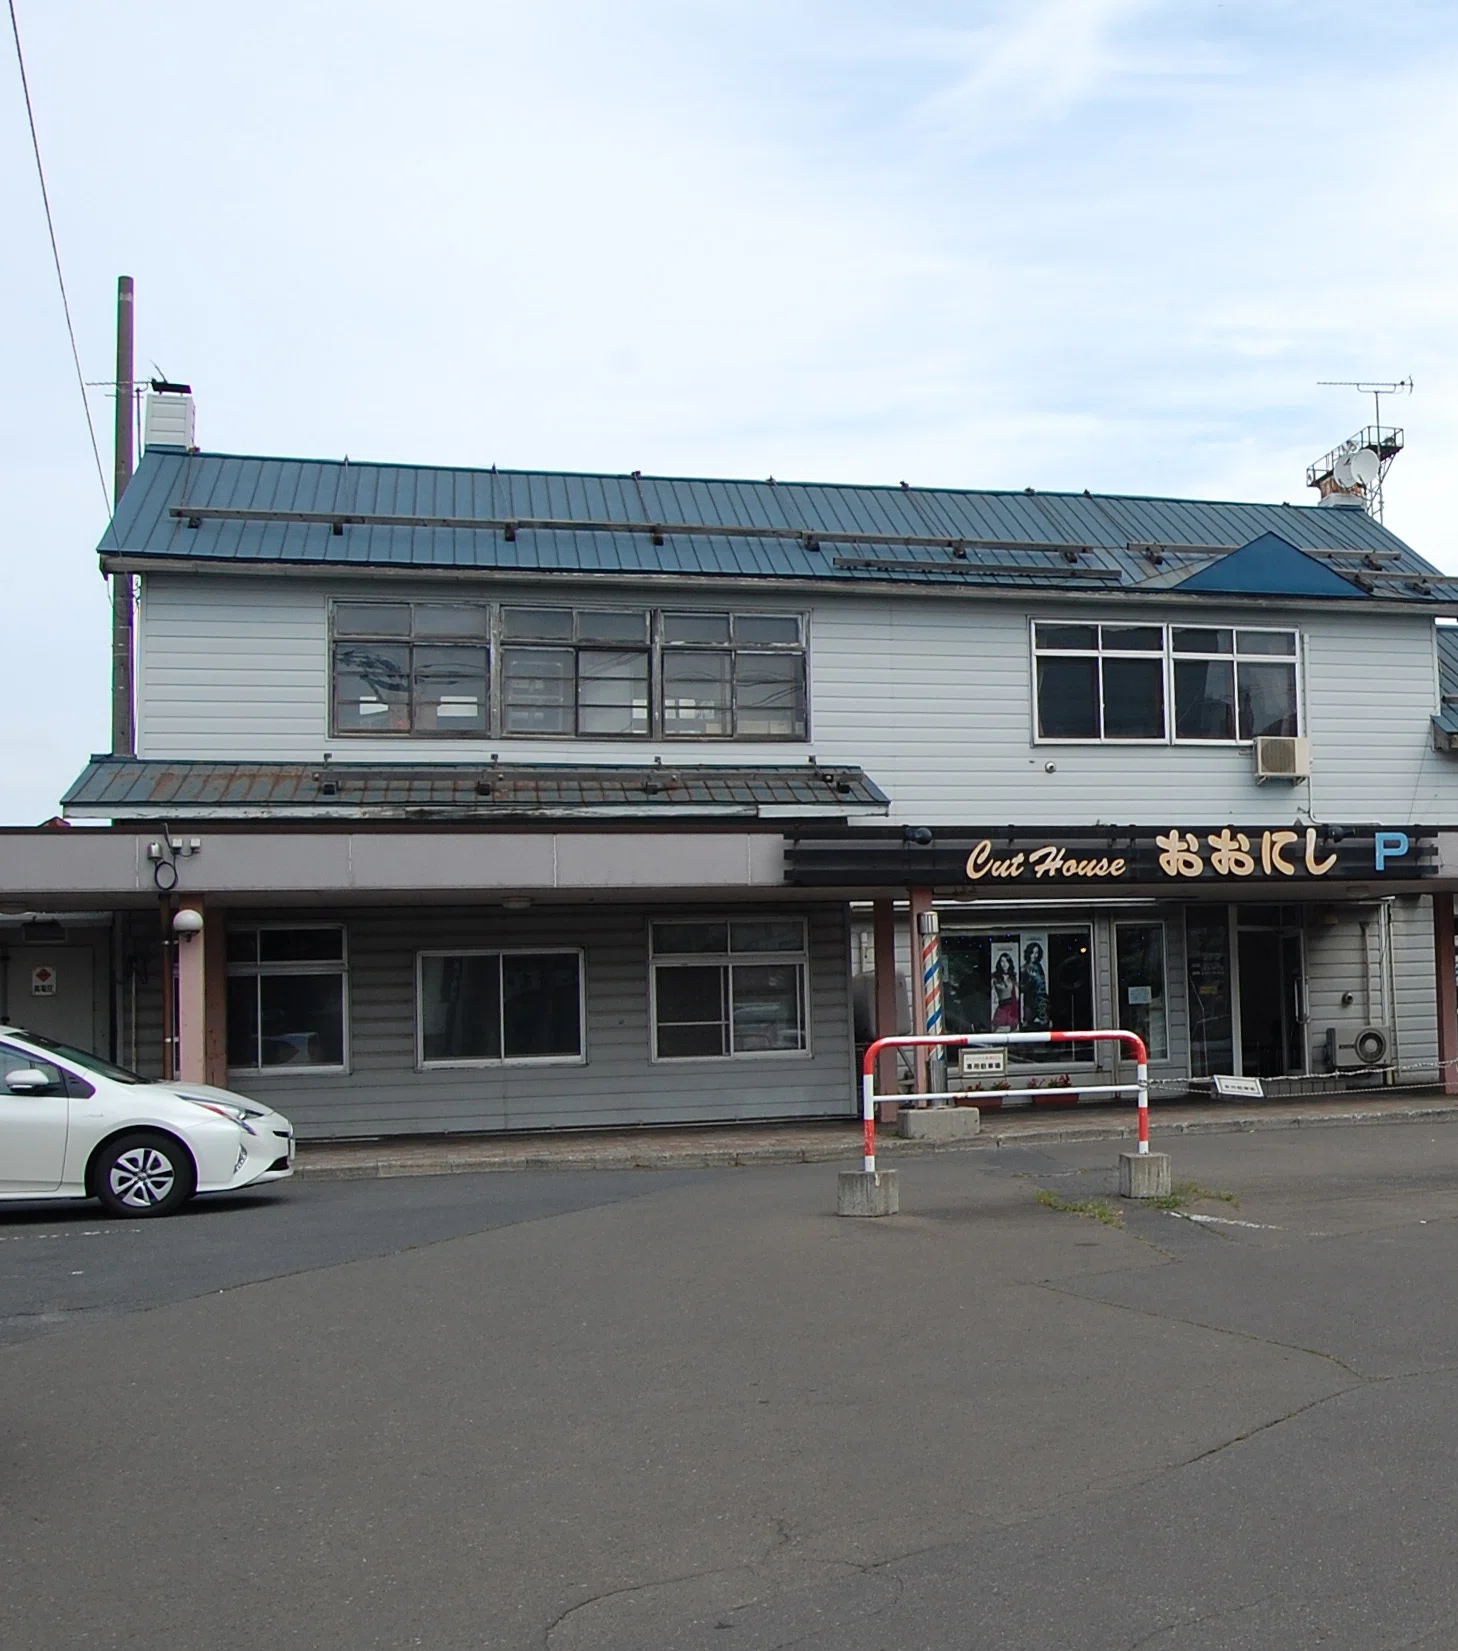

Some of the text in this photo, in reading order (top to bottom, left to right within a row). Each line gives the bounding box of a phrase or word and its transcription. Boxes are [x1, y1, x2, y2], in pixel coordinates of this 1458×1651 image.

[966, 839, 1126, 879] Cut House
[1155, 828, 1337, 877] おおにし
[1375, 832, 1409, 871] P
